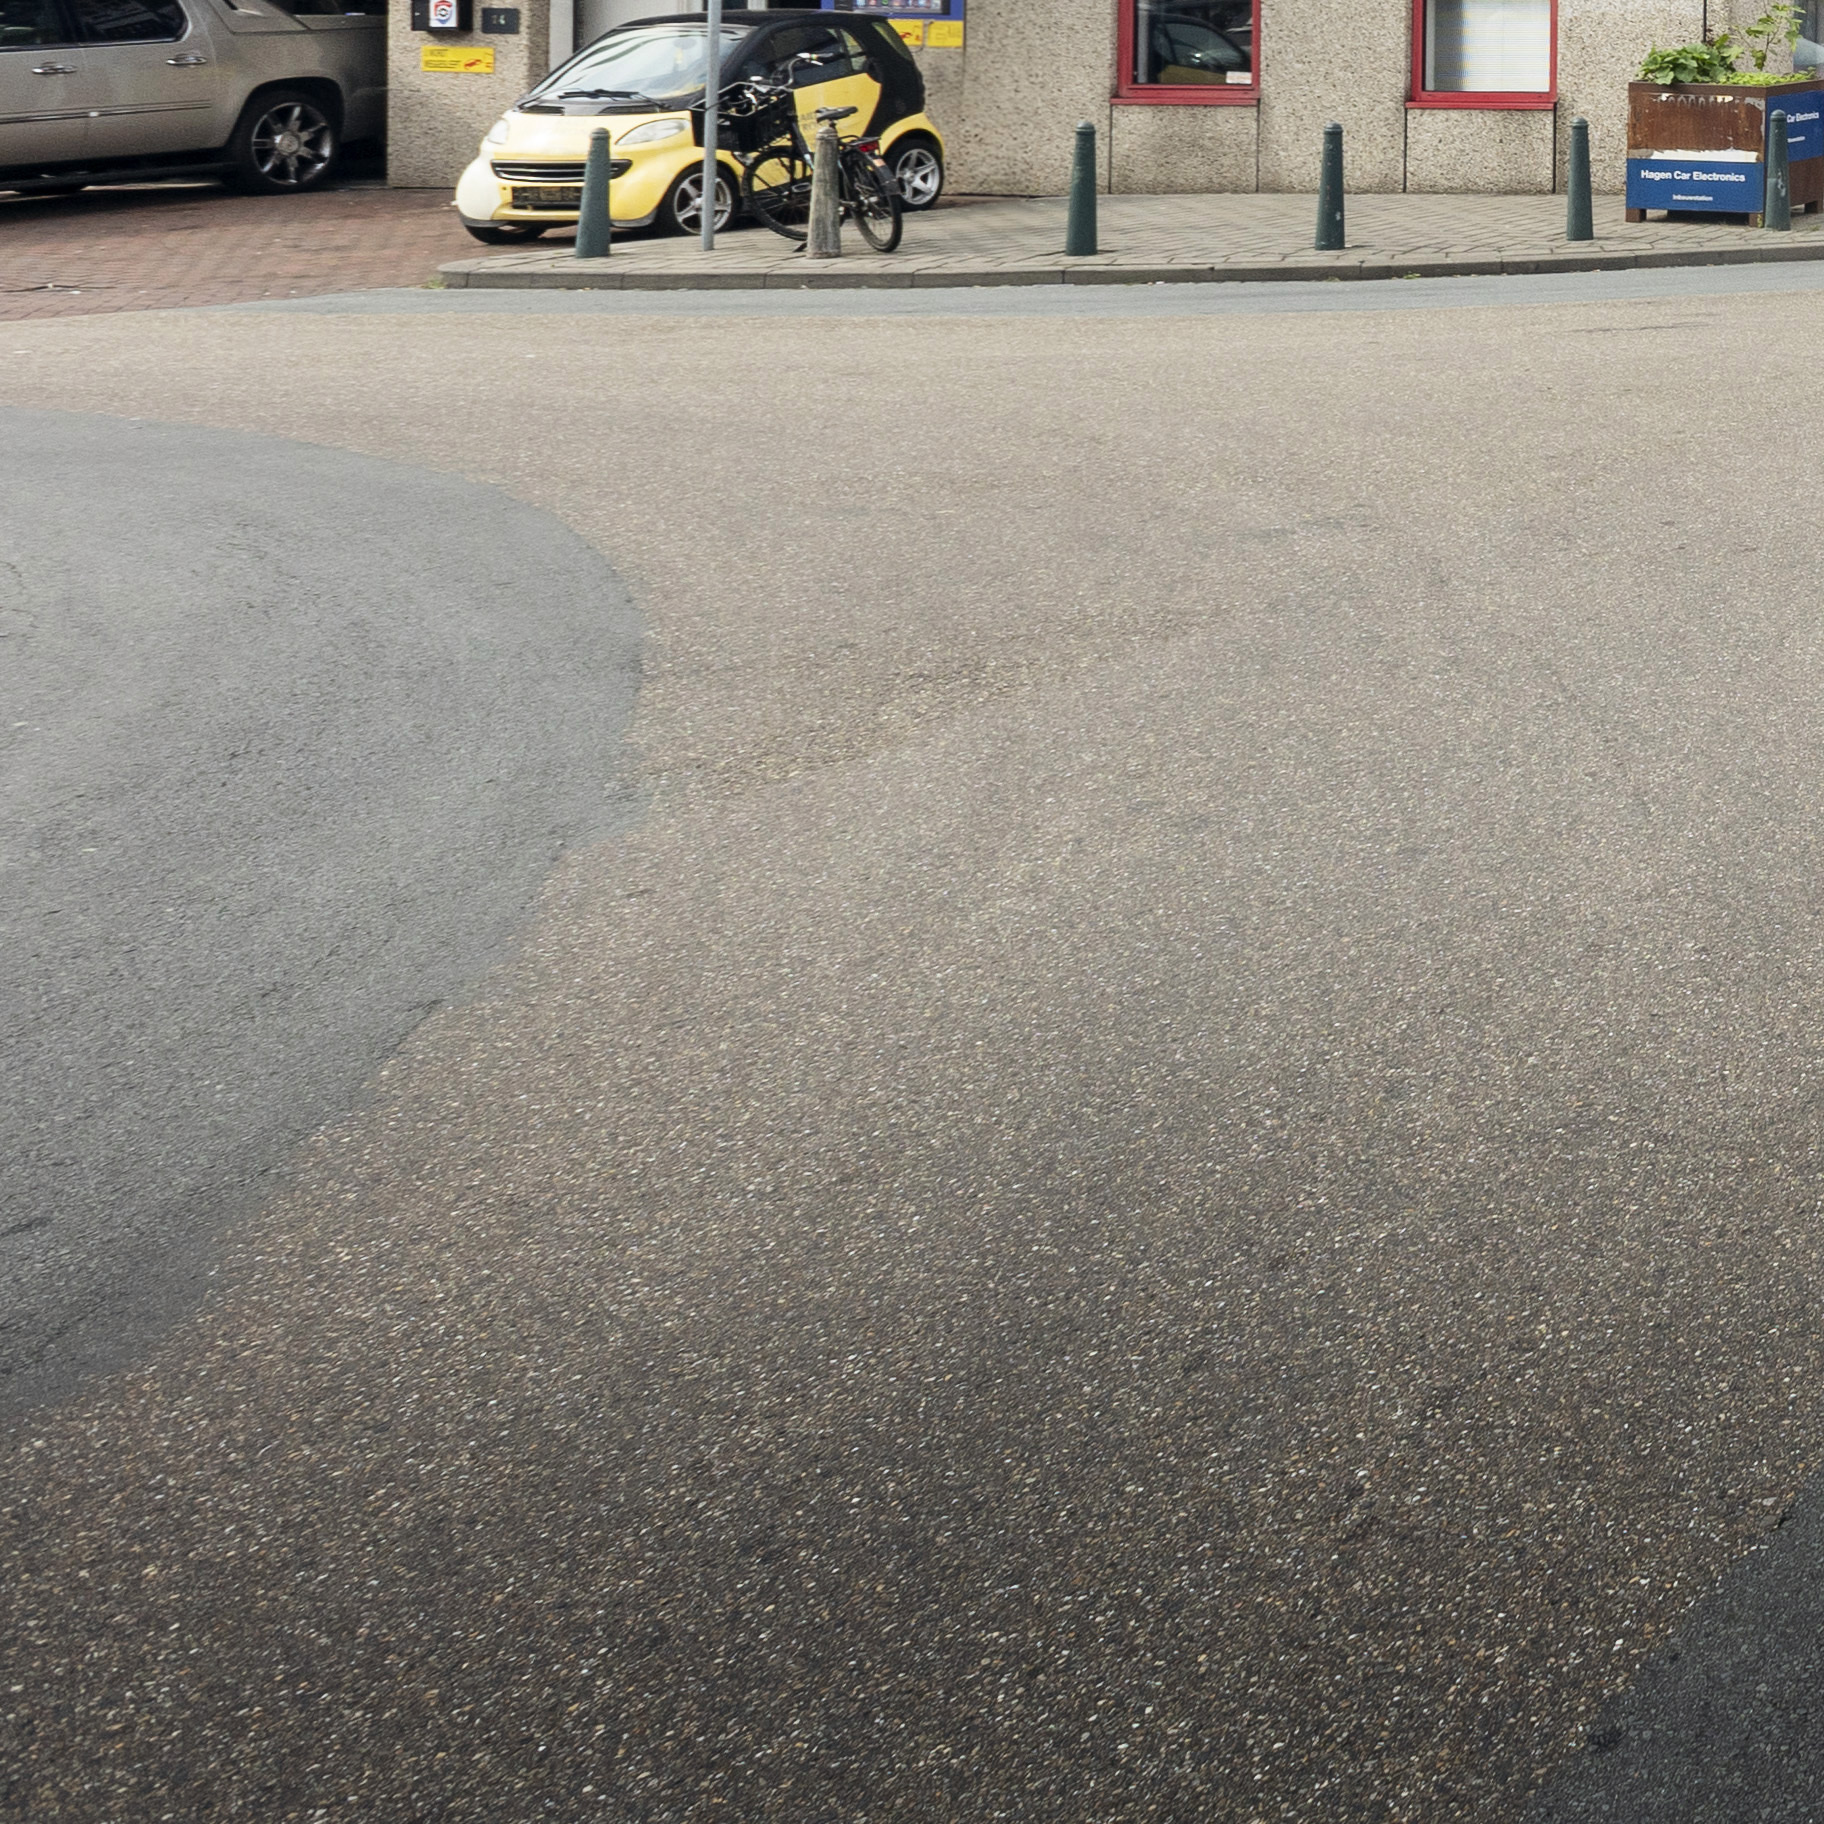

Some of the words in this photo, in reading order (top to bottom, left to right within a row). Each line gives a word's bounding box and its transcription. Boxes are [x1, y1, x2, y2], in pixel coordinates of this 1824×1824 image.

[1641, 169, 1672, 181] Hagen
[1674, 170, 1690, 180] Car
[1693, 171, 1745, 183] Electronics
